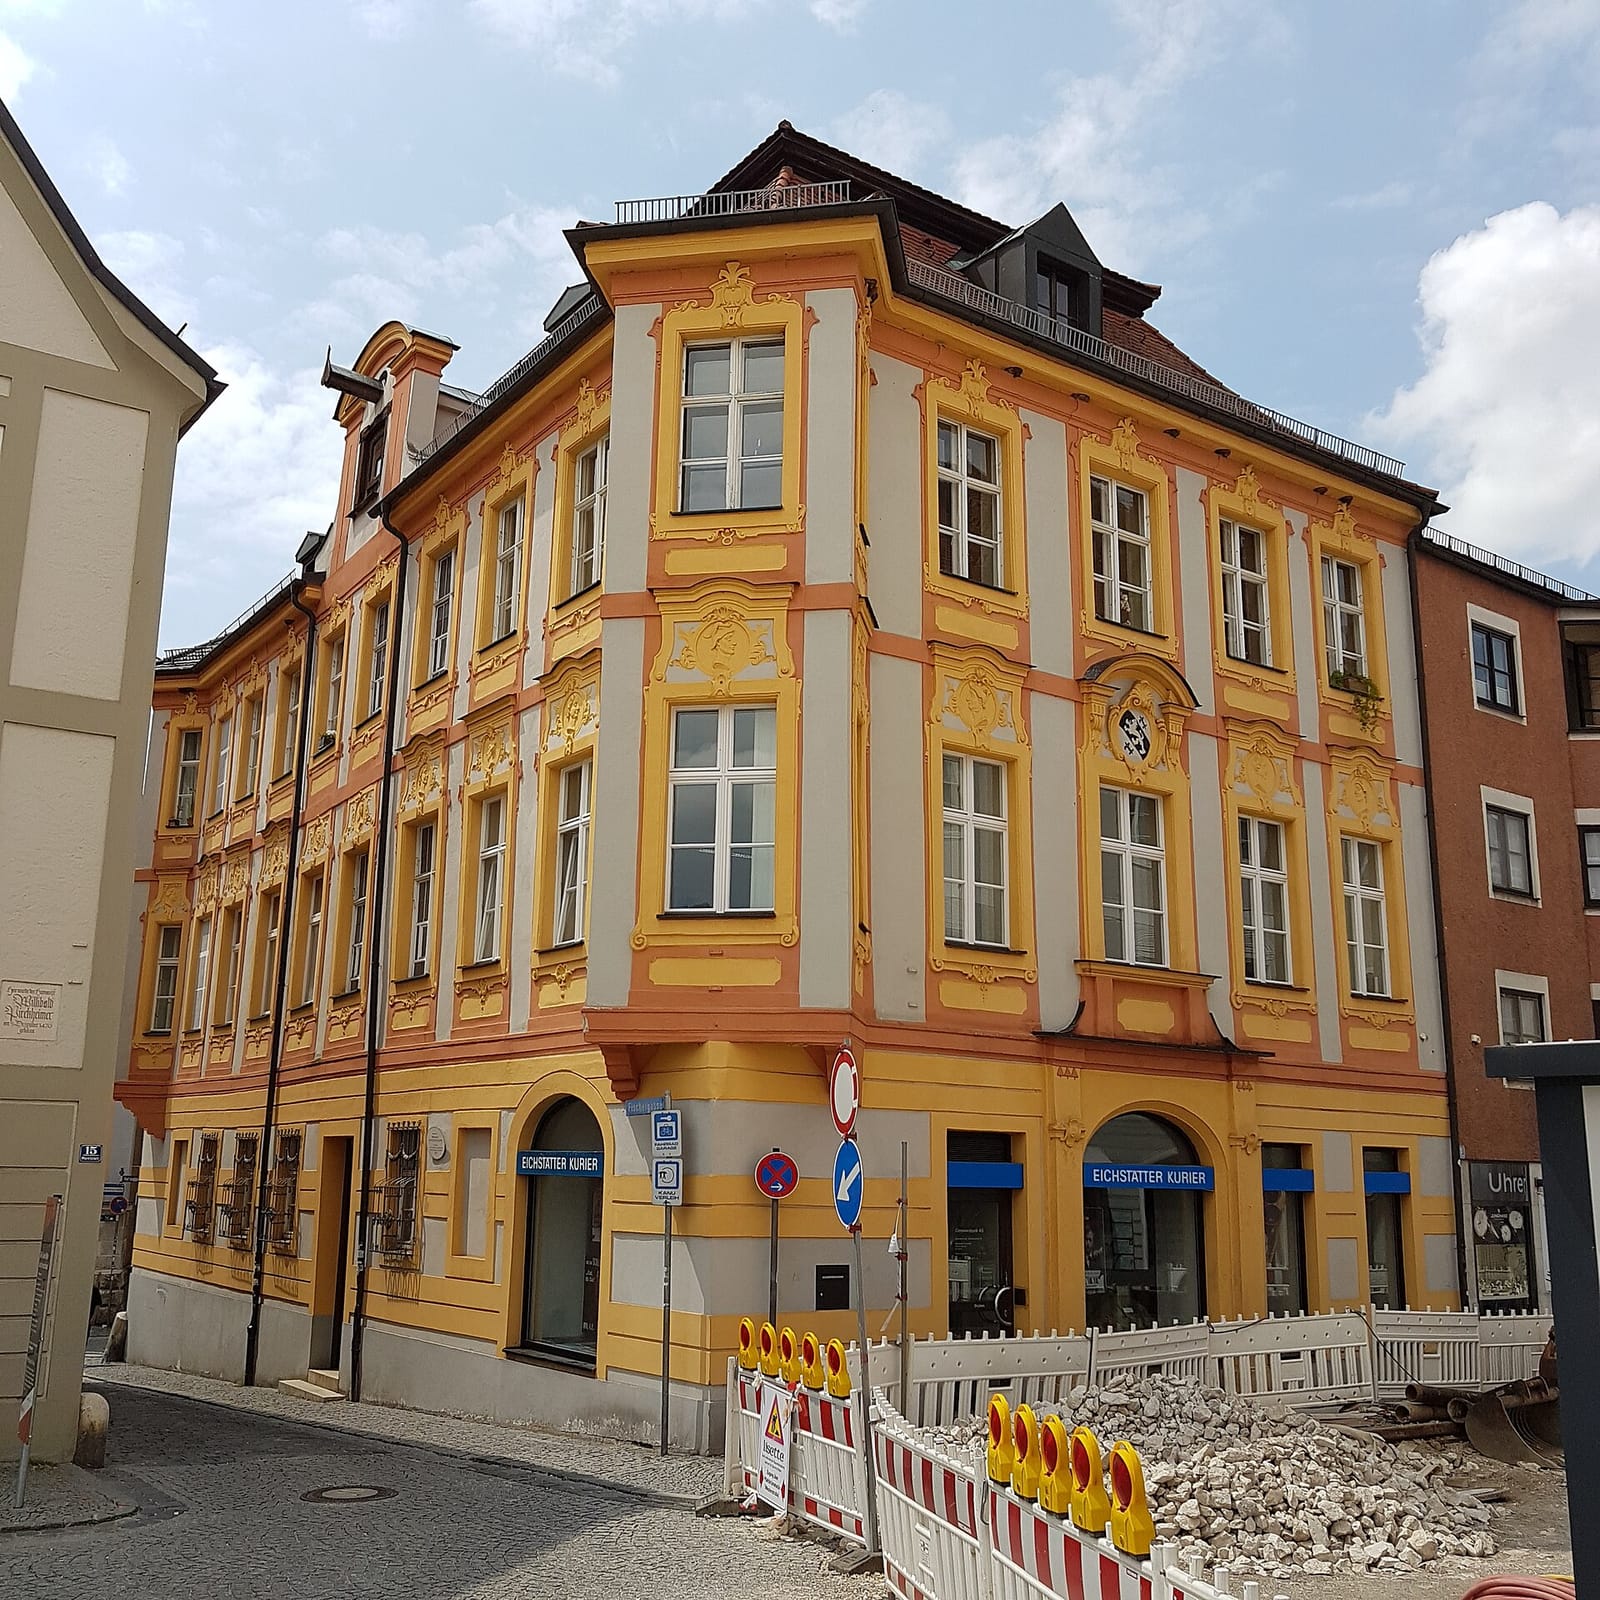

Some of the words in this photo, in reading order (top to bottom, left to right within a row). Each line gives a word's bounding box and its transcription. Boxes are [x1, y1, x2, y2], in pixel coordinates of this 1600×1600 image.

[86, 1146, 98, 1155] 15
[569, 1157, 598, 1171] KURIER
[1167, 1170, 1206, 1184] KURIER
